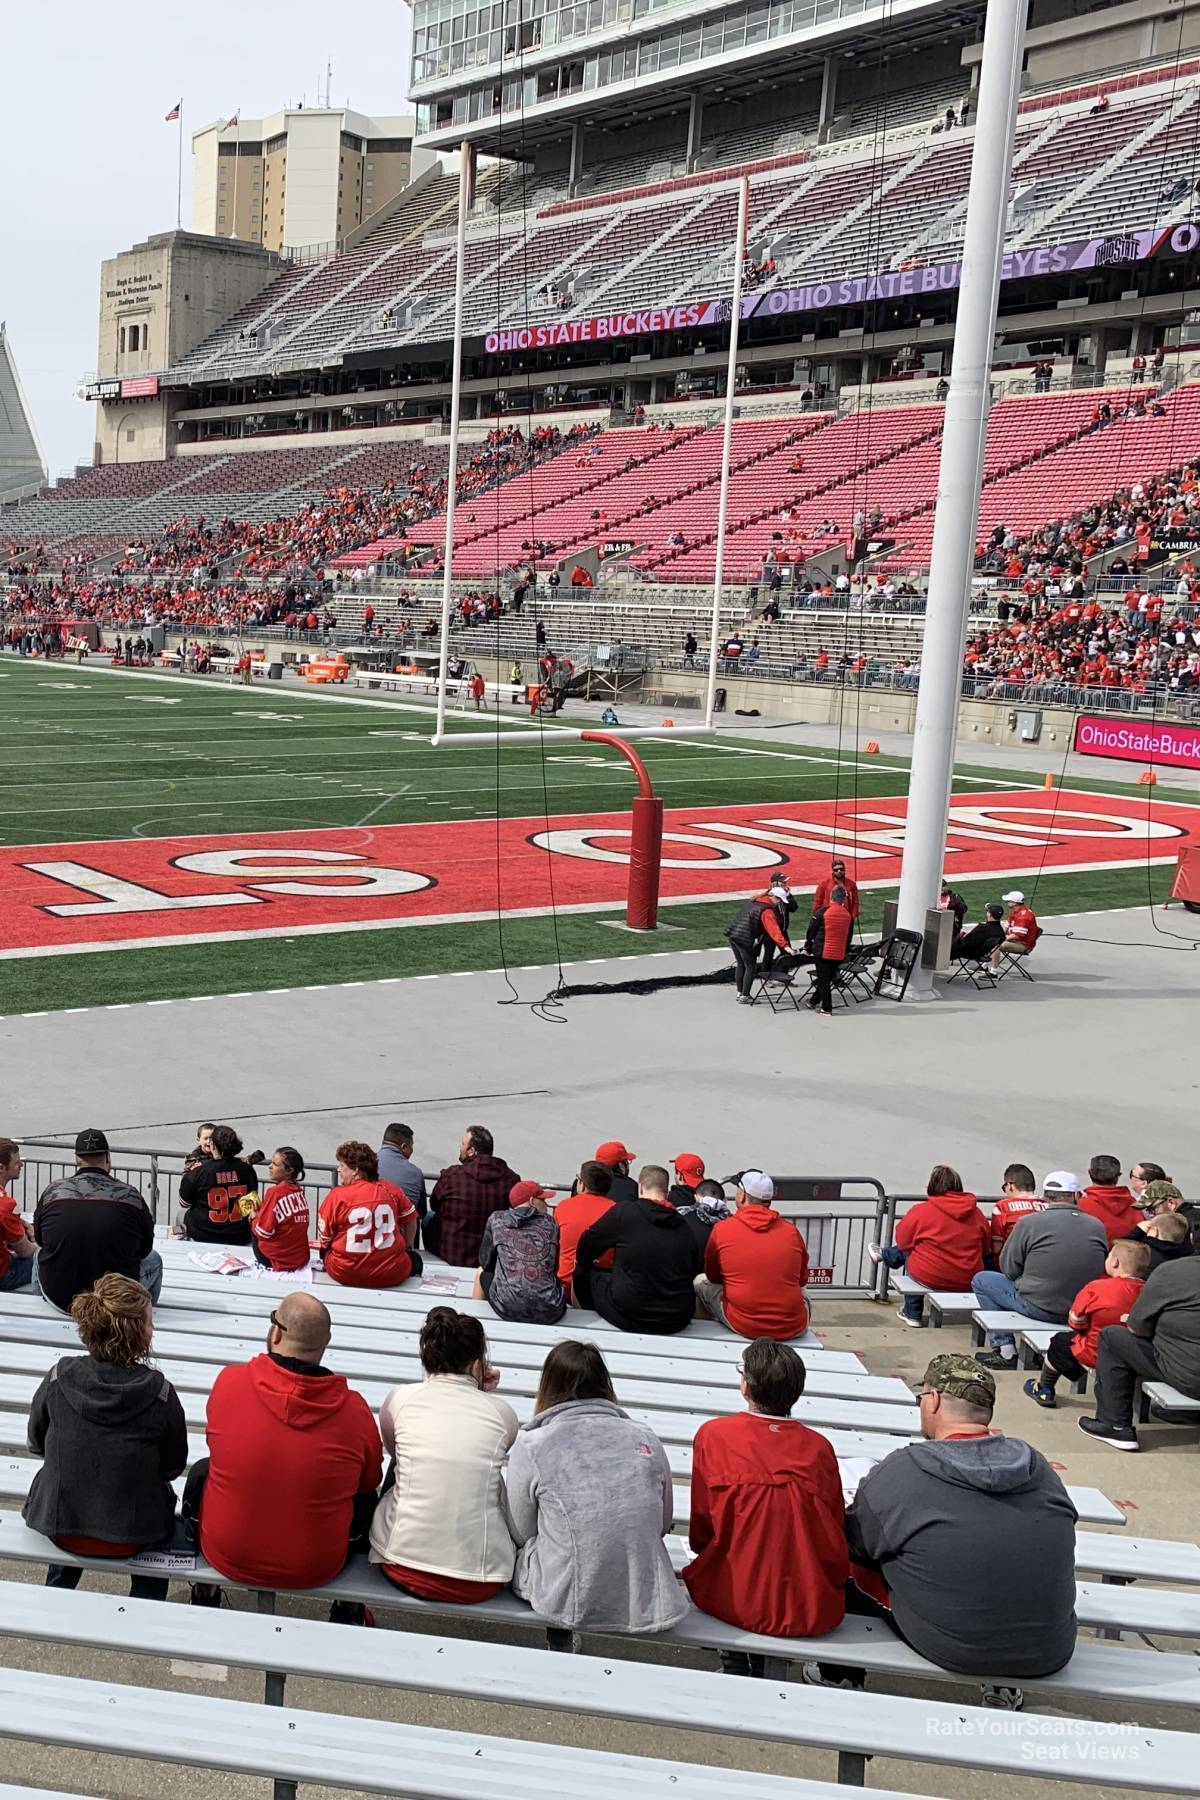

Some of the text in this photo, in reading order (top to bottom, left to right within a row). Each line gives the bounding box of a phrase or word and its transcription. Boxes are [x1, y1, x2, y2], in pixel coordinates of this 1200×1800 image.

[769, 284, 832, 315] OHIO
[838, 271, 914, 305] STATE
[485, 304, 702, 352] OHIO STATE BUCKEYES
[1159, 540, 1199, 551] CAMBRIA
[207, 1185, 248, 1223] 97
[1008, 1200, 1032, 1212] OHIO
[345, 1204, 396, 1253] 28
